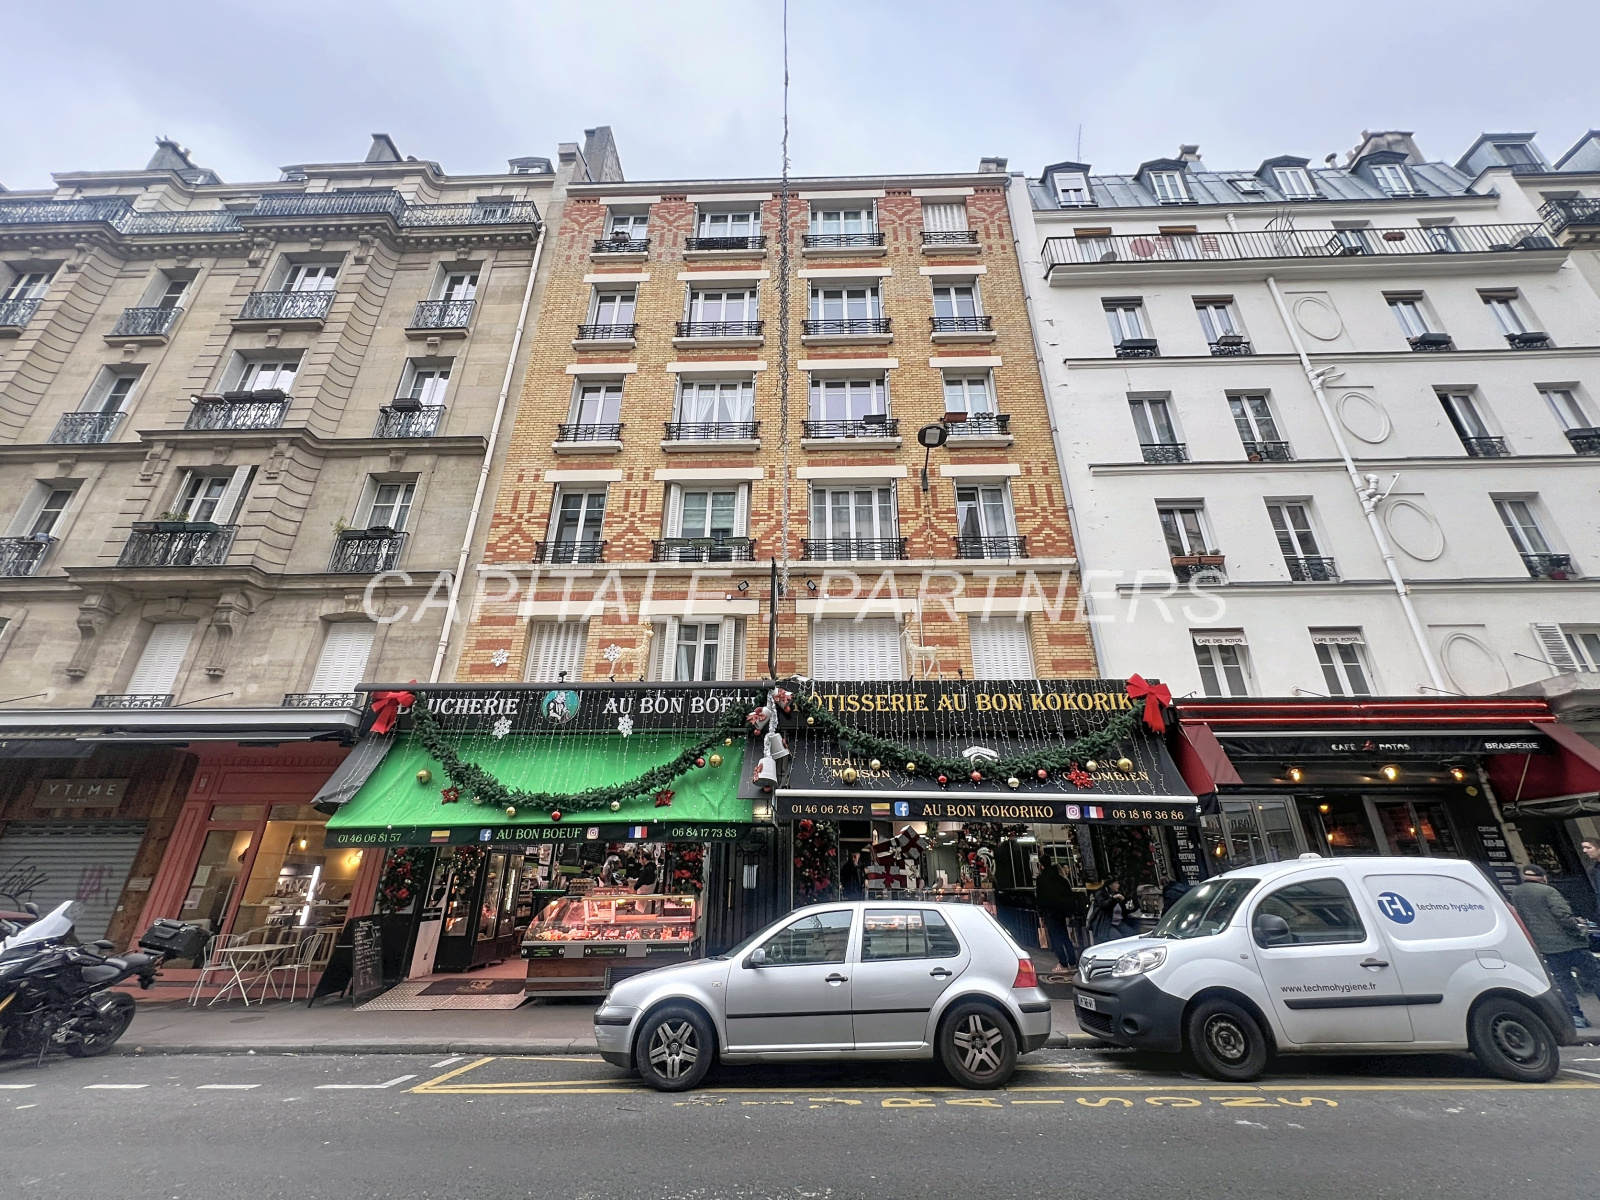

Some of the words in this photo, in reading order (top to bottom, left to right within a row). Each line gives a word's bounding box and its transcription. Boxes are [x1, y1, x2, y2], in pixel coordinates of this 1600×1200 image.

[397, 698, 520, 715] BUCHERIE
[602, 697, 632, 714] AU
[639, 697, 683, 714] BON
[937, 693, 967, 712] AU
[976, 693, 1022, 711] BON
[1031, 693, 1137, 712] KOKORIK
[832, 769, 891, 778] MISON
[791, 804, 802, 814] 01
[804, 804, 818, 814] 46
[820, 804, 834, 814] 06
[836, 803, 850, 814] 78
[852, 804, 864, 815] 57
[922, 804, 941, 816] AU
[946, 804, 976, 817] BON
[981, 804, 1054, 818] KOKORIKO
[1112, 809, 1126, 819] 06
[1127, 808, 1140, 819] 18
[1141, 810, 1152, 820] 16
[1154, 811, 1168, 820] 36
[1170, 809, 1184, 820] 86
[338, 834, 349, 843] 01
[349, 834, 362, 843] 46
[363, 833, 377, 843] 06
[377, 832, 388, 843] 81
[389, 833, 402, 842] 57
[496, 828, 514, 840] AU
[515, 828, 540, 840] BON
[542, 827, 582, 839] BOEUF
[672, 827, 685, 837] 06
[685, 826, 699, 837] 84
[700, 828, 710, 837] 17
[710, 828, 723, 838] 73
[724, 827, 737, 838] 83
[1416, 903, 1450, 911] techmo
[1450, 903, 1485, 912] hygiène
[1280, 982, 1376, 993] www.techmohygiene.fr
